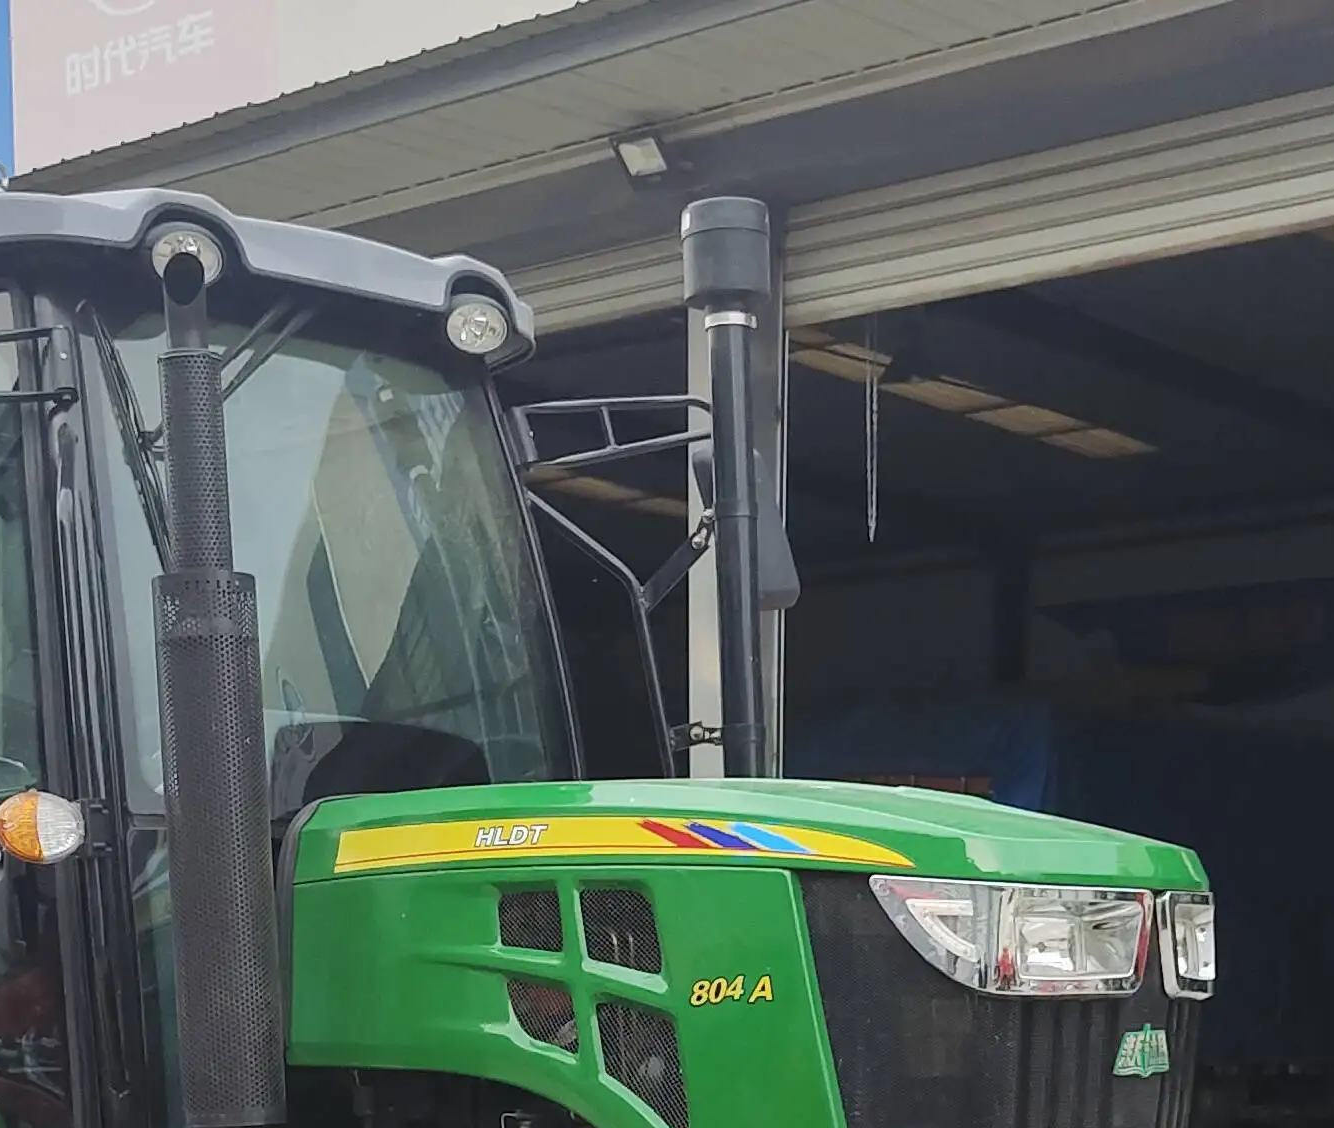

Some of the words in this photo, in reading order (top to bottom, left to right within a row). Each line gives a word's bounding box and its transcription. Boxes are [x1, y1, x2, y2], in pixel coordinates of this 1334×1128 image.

[66, 10, 216, 97] 时代汽车
[474, 823, 549, 848] HLDT
[689, 974, 746, 1008] 804
[747, 974, 774, 1005] A
